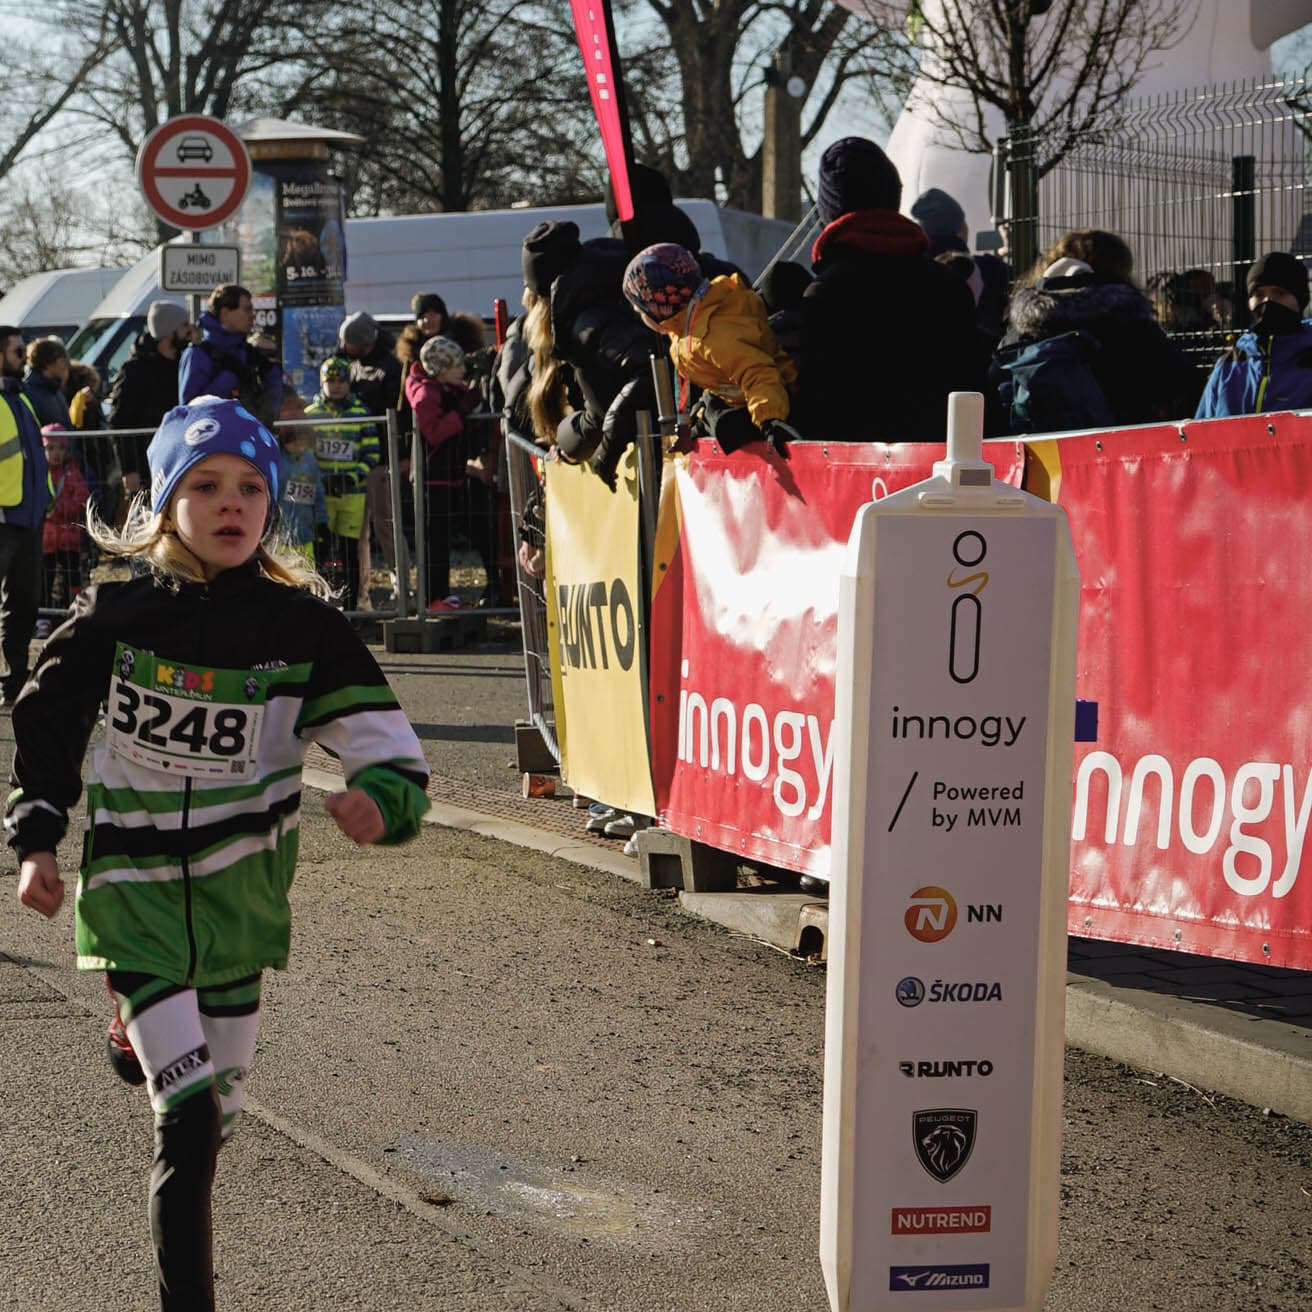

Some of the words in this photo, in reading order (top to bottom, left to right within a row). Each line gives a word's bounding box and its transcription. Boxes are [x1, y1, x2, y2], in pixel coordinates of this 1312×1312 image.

[187, 253, 216, 266] MIMO
[111, 682, 248, 757] 3248
[891, 705, 1027, 747] innogy
[678, 658, 837, 821] innogy
[933, 780, 1024, 801] Powered
[931, 807, 959, 833] by
[967, 807, 1022, 827] MVM
[1072, 750, 1312, 899] nnogy
[967, 904, 1003, 923] NN
[928, 979, 1003, 1003] ŠKODA
[917, 1059, 994, 1078] RUNTO
[918, 1113, 971, 1124] PEUGEOT
[897, 1212, 986, 1229] NUTREND
